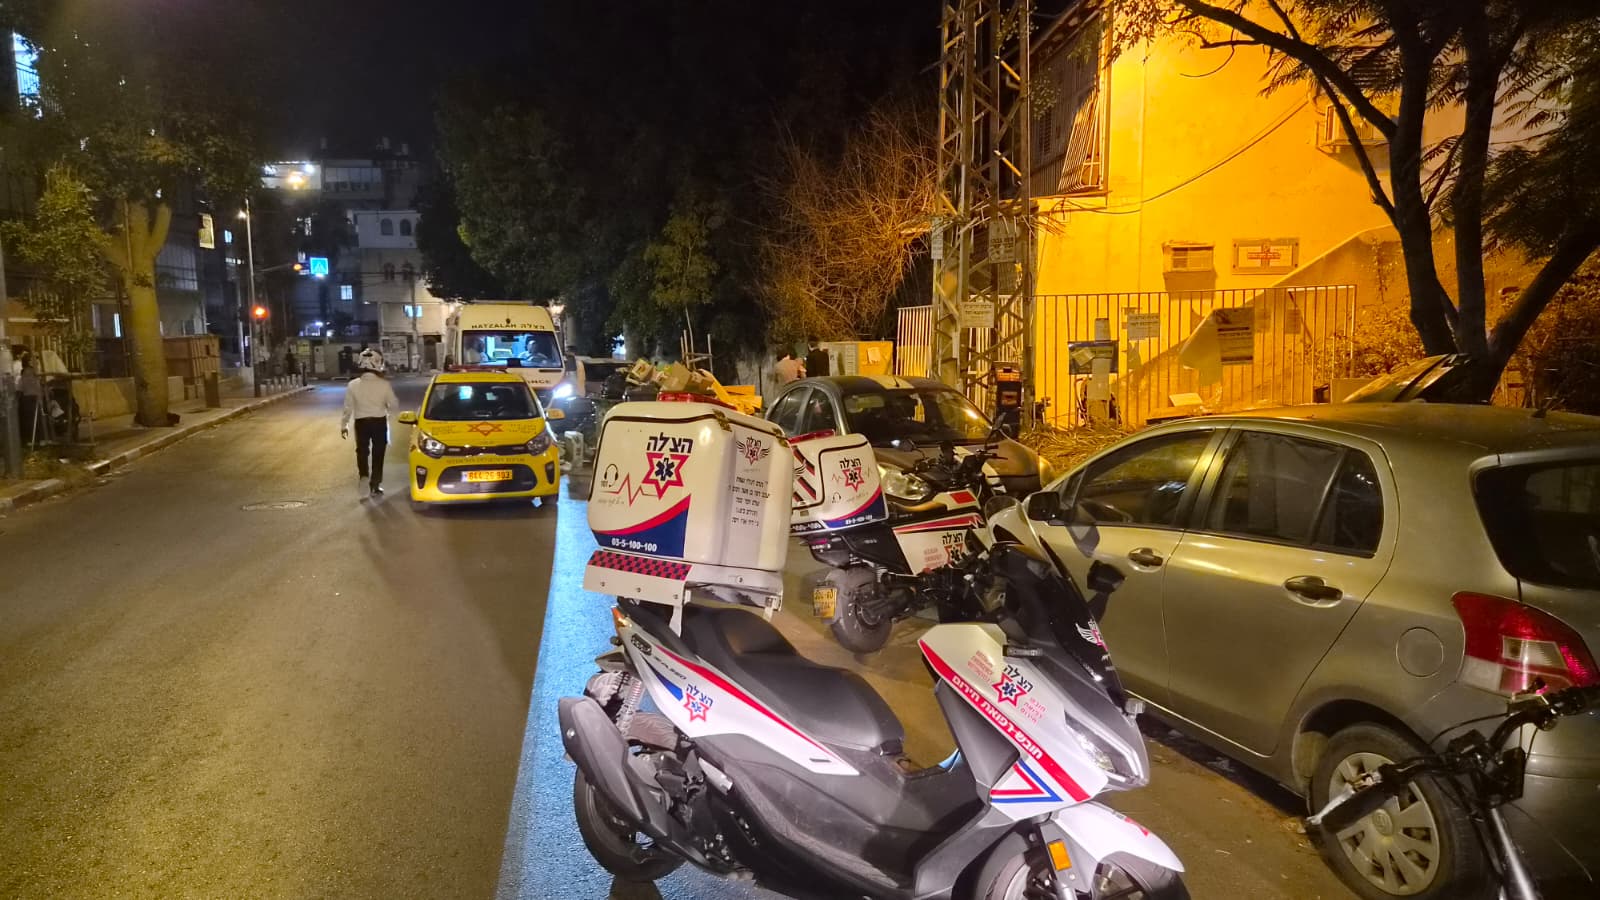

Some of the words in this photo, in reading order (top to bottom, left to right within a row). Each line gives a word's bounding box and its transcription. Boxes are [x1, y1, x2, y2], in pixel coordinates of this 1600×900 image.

[646, 432, 694, 454] הצלה
[839, 457, 862, 469] הצלה
[611, 537, 657, 552] 03-5-100-100
[942, 532, 963, 545] הצלה
[951, 675, 982, 703] חירום
[1003, 664, 1033, 692] הצלה
[686, 683, 714, 707] הצלה
